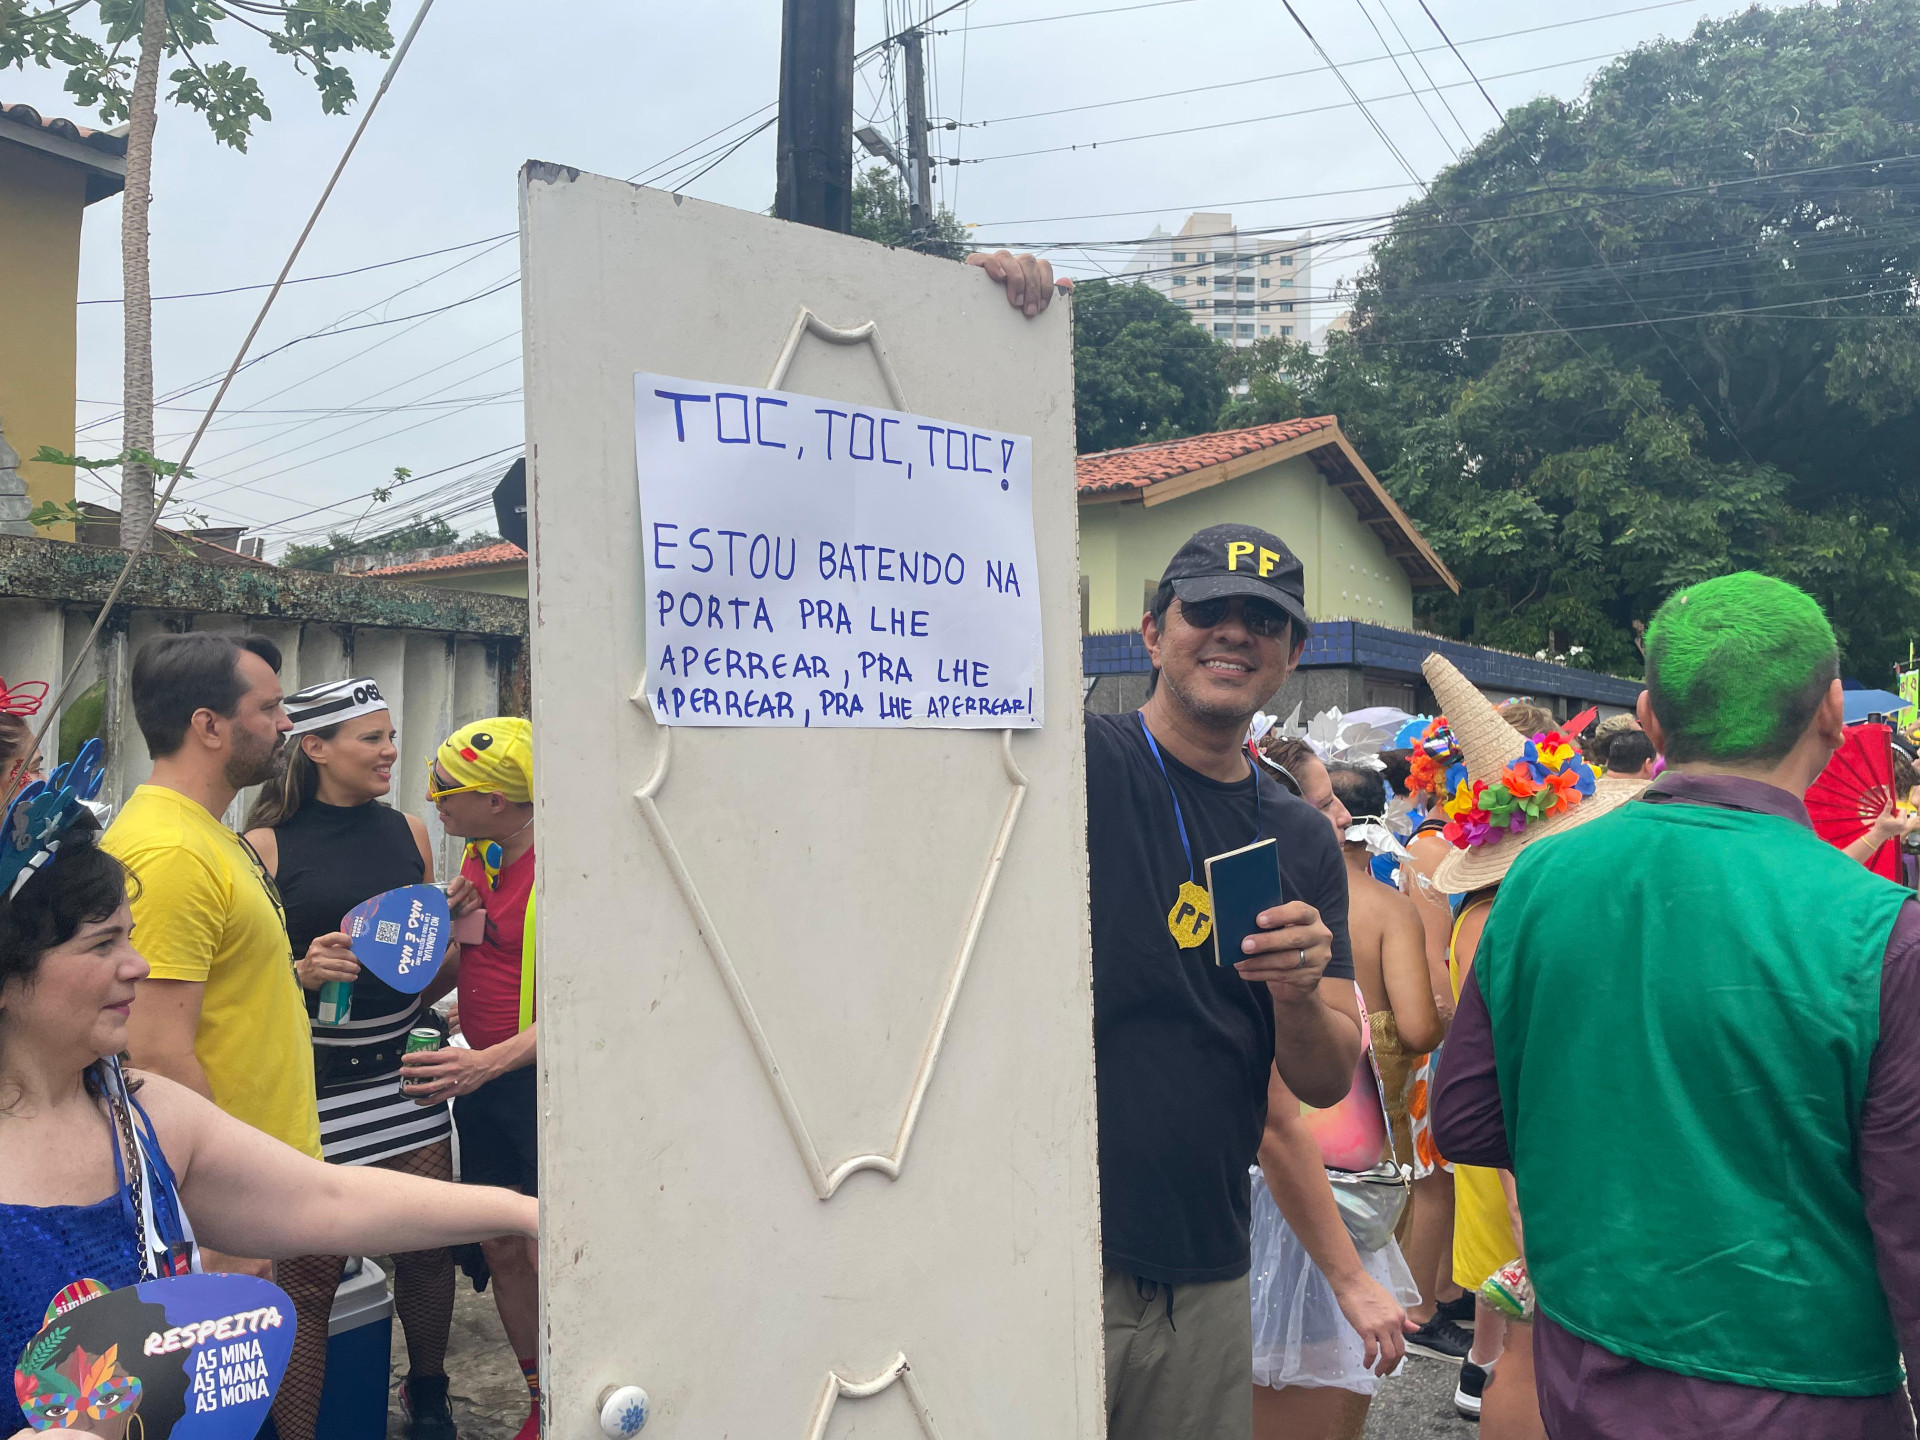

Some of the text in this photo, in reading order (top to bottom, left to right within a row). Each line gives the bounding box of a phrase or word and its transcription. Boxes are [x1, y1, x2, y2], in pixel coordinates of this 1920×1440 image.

[918, 425, 1014, 490] TOC!
[654, 523, 1020, 597] ESTOU BATENDO NA
[1228, 541, 1280, 578] PF
[657, 590, 928, 637] PORTA PRA LHE
[858, 651, 912, 684] PRA
[938, 659, 989, 687] LHE
[819, 686, 863, 717] PRA
[880, 692, 912, 719] LHE
[928, 685, 1032, 721] APERREAR!
[1176, 902, 1210, 935] PF
[398, 900, 424, 974] NÃO É NÃO
[422, 927, 438, 962] CARNAVAL
[143, 1306, 283, 1357] RESPEITA
[195, 1338, 264, 1372] AS MINA
[193, 1358, 269, 1394] AS MANA
[195, 1378, 270, 1414] AS MONA
